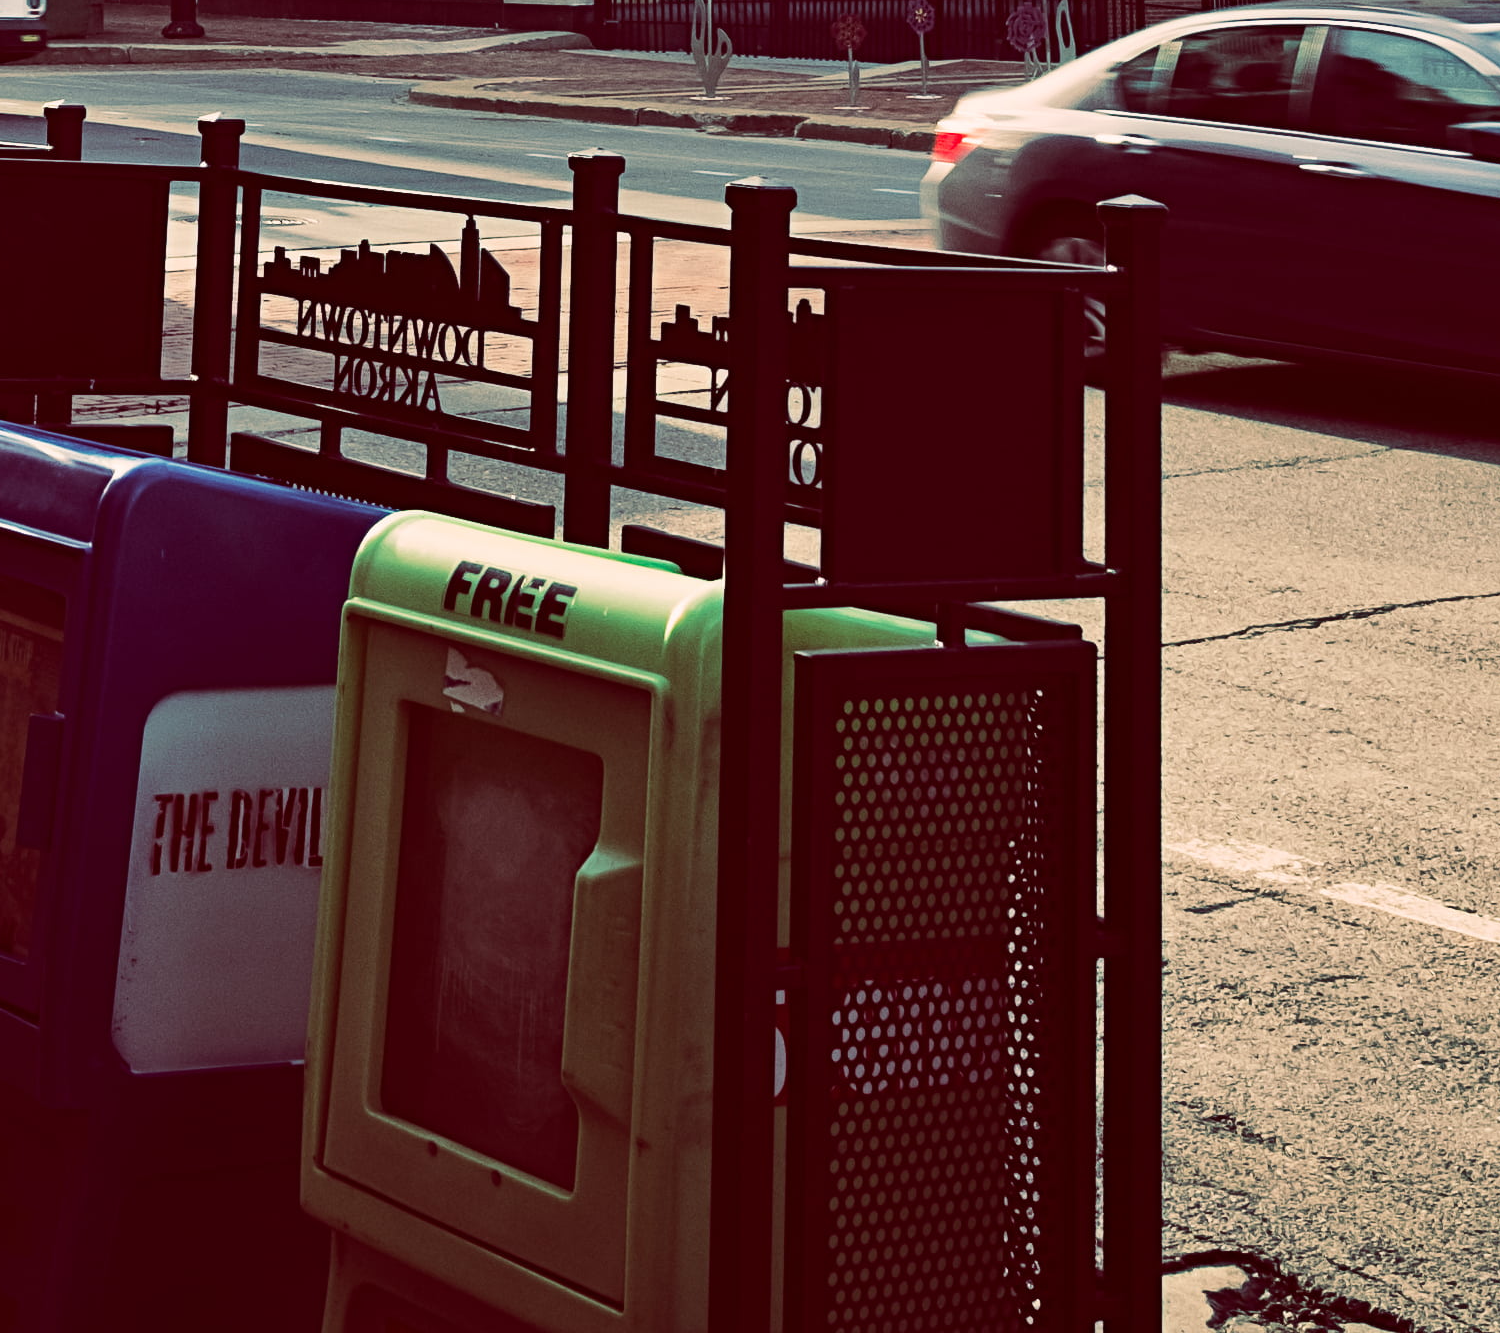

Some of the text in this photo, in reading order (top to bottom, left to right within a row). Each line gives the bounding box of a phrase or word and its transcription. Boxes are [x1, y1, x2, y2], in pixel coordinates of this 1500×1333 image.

[441, 560, 578, 639] FREE
[150, 787, 323, 876] THE DEVIL
